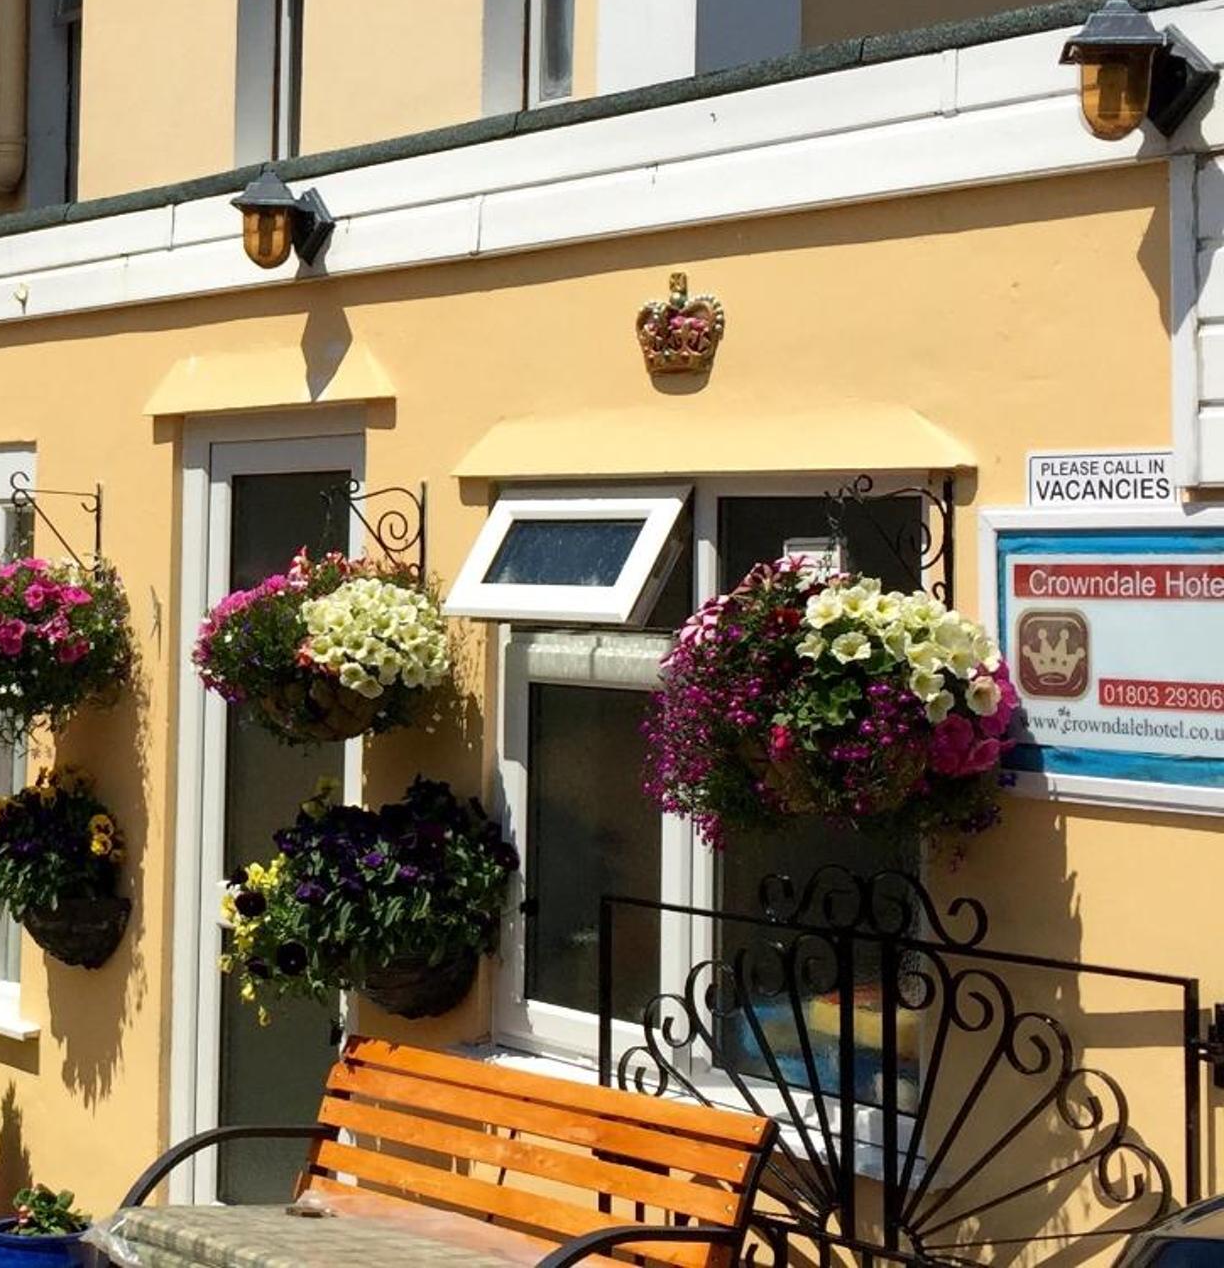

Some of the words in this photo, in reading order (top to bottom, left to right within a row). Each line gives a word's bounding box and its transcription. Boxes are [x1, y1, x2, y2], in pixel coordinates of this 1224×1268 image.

[1040, 460, 1100, 476] PLEASE
[1103, 459, 1144, 475] CALL
[1148, 459, 1165, 474] IN
[1036, 477, 1171, 501] VACANCIES
[1028, 568, 1157, 597] Crowndale
[1103, 683, 1160, 706] 01803
[1164, 686, 1224, 710] 29306
